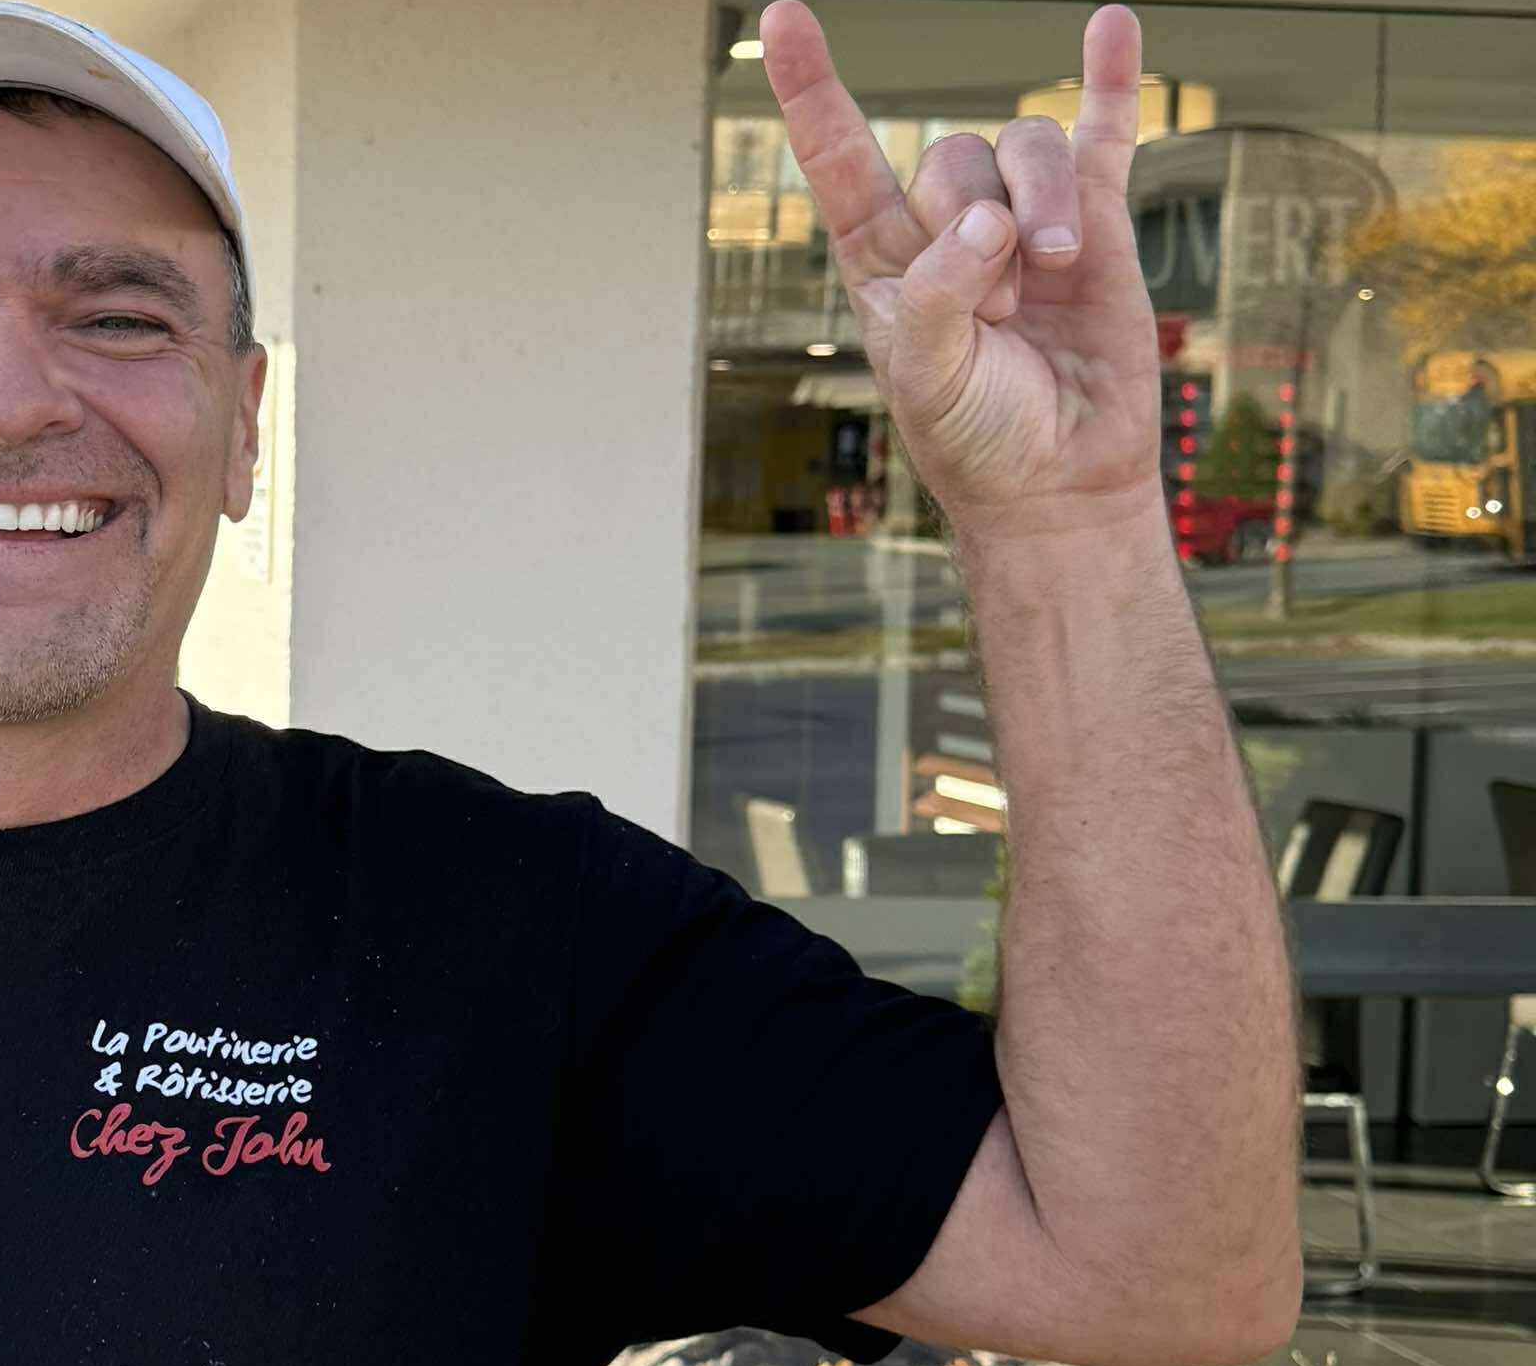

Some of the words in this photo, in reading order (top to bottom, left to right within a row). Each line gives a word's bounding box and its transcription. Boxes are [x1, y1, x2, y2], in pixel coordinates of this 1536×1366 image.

[1142, 195, 1360, 290] UVERT
[91, 1019, 130, 1056] La
[142, 1022, 318, 1065] Poutinerie
[93, 1061, 123, 1097] &
[135, 1062, 313, 1106] Rôtisserie
[69, 1102, 192, 1186] Chez
[201, 1111, 331, 1176] John
